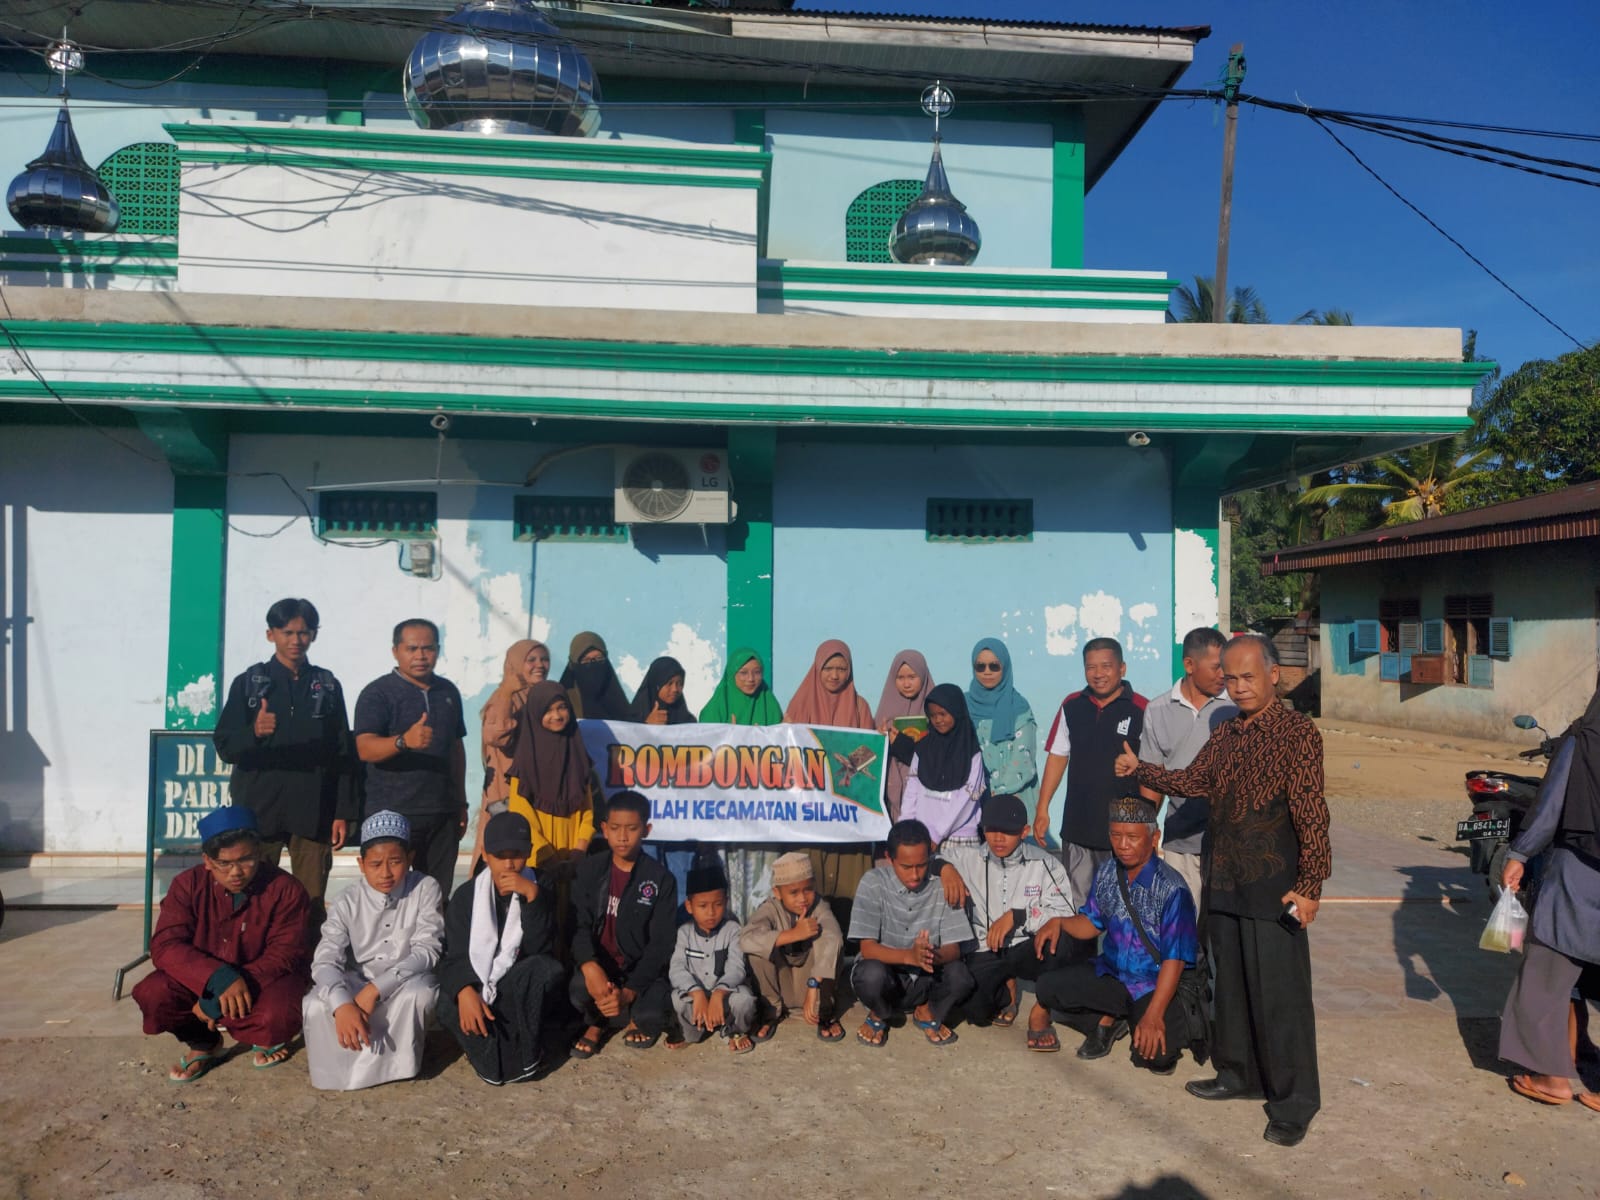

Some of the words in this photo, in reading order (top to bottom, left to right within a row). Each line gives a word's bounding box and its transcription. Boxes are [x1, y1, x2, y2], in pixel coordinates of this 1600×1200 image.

[702, 477, 718, 488] LG
[176, 743, 206, 776] DI
[607, 744, 826, 789] ROMBONGAN
[163, 780, 233, 808] PARK
[164, 811, 210, 839] DE
[692, 800, 798, 822] KECAMATAN
[802, 801, 858, 823] SILAUT
